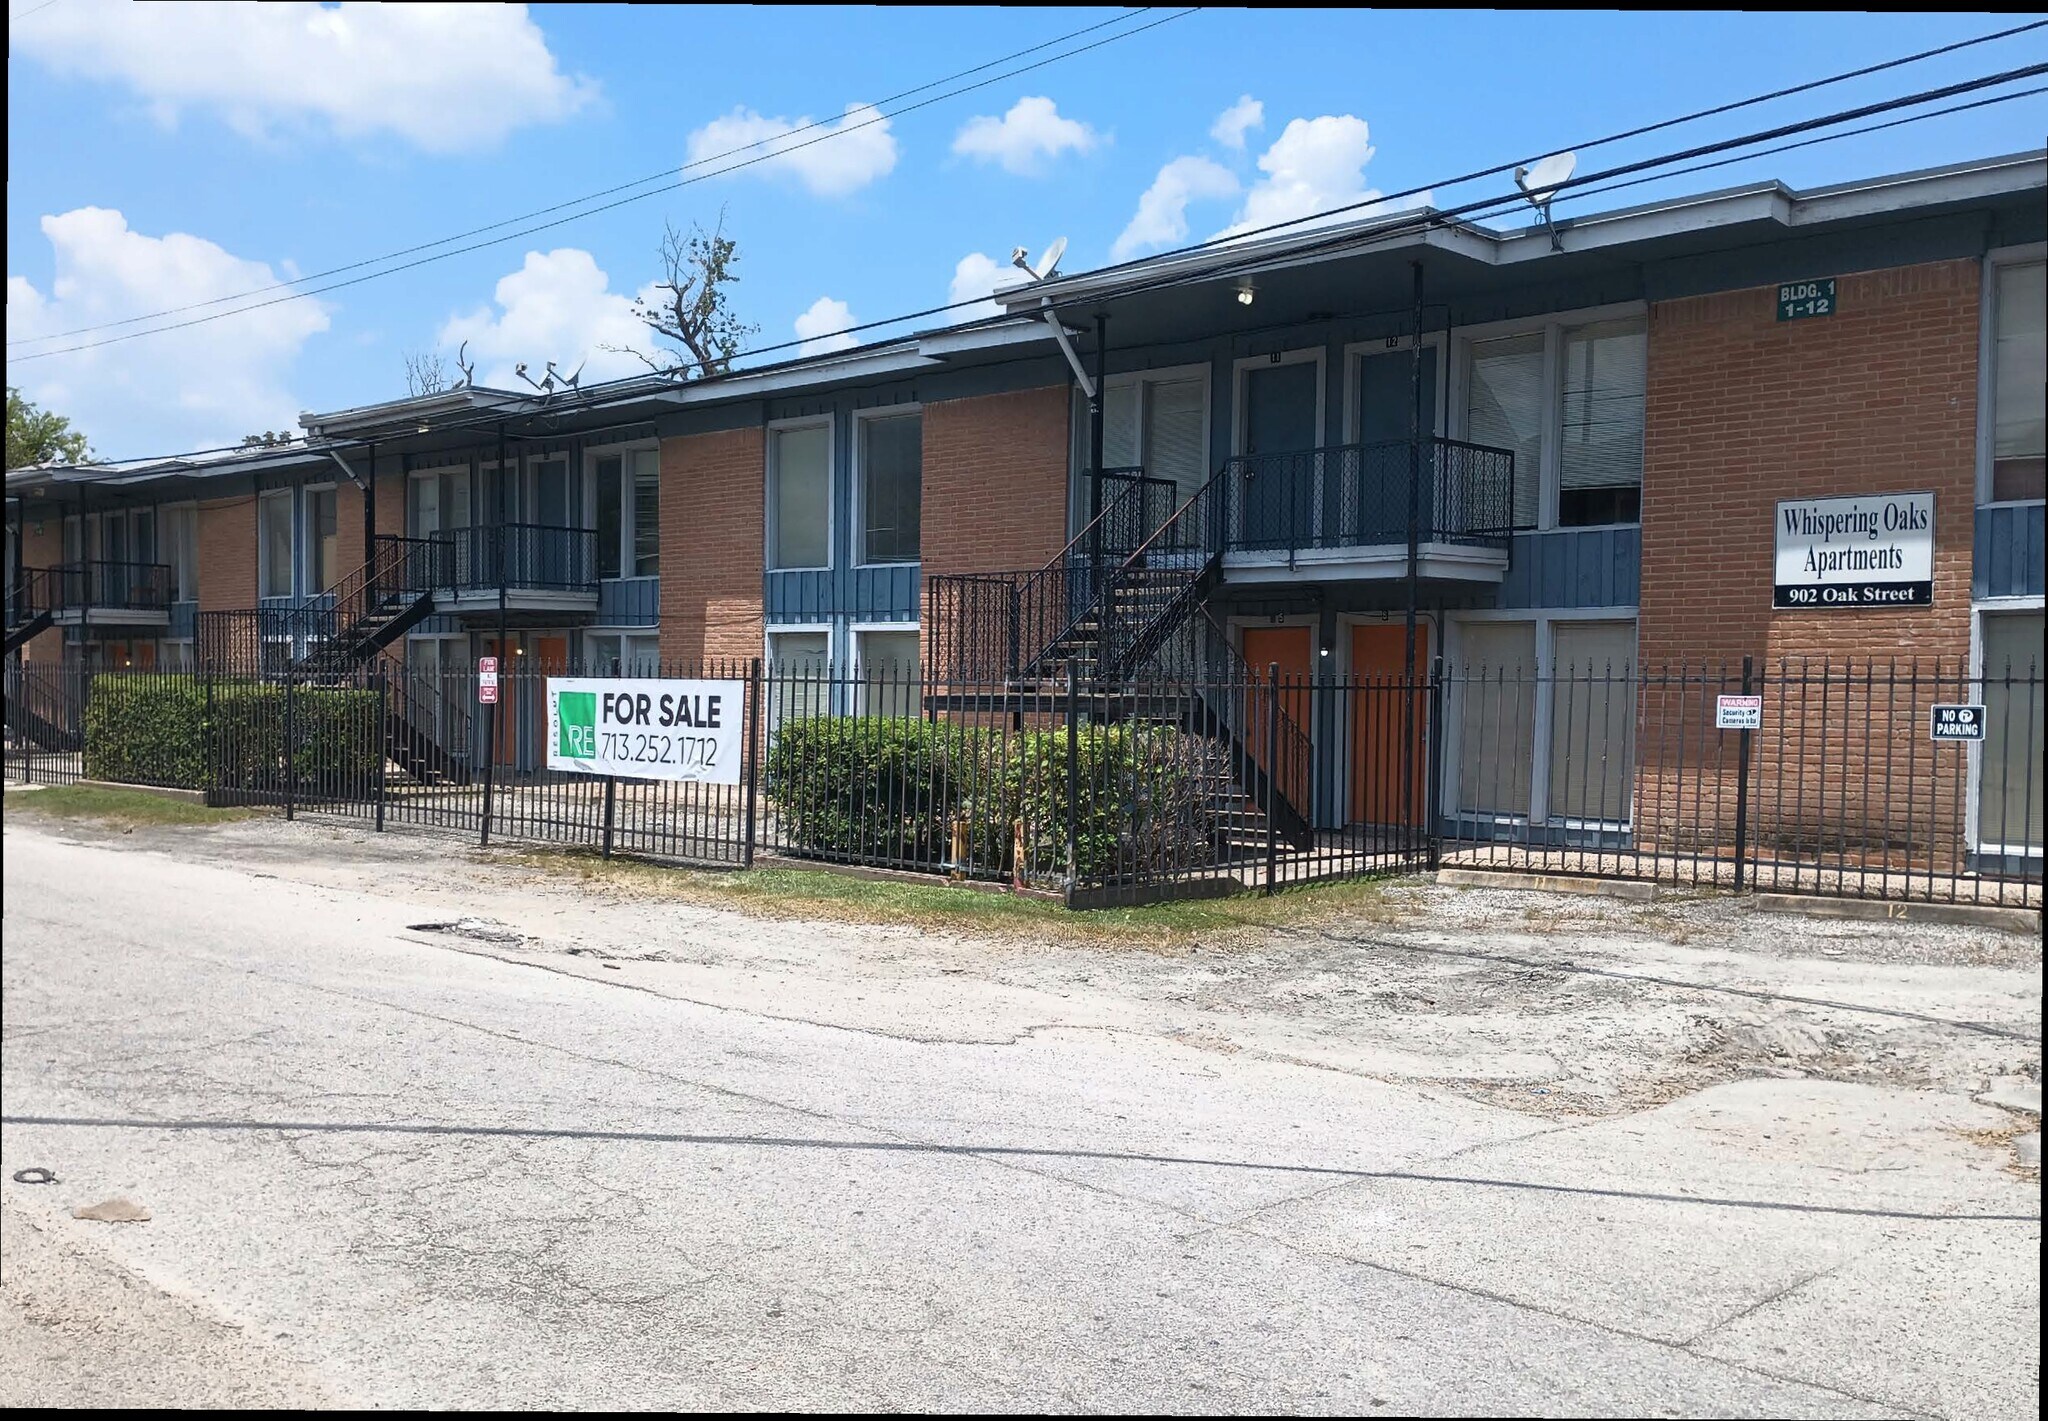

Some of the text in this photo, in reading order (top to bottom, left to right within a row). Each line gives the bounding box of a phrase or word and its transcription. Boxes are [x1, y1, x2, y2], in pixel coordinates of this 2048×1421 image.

[1781, 280, 1835, 302] BLDG. 1
[1785, 298, 1829, 317] 1-12
[1784, 501, 1928, 543] Whispering Oaks
[1804, 542, 1903, 579] Apartments
[1789, 586, 1915, 603] 902 Oak Street
[603, 692, 721, 728] FOR SALE
[1721, 698, 1759, 707] WARNING
[1722, 709, 1745, 717] Security
[1942, 709, 1956, 722] NO
[1936, 722, 1978, 736] PARKING
[568, 724, 595, 756] RE
[602, 732, 718, 767] 713.252.1712
[1888, 904, 1908, 918] 12
